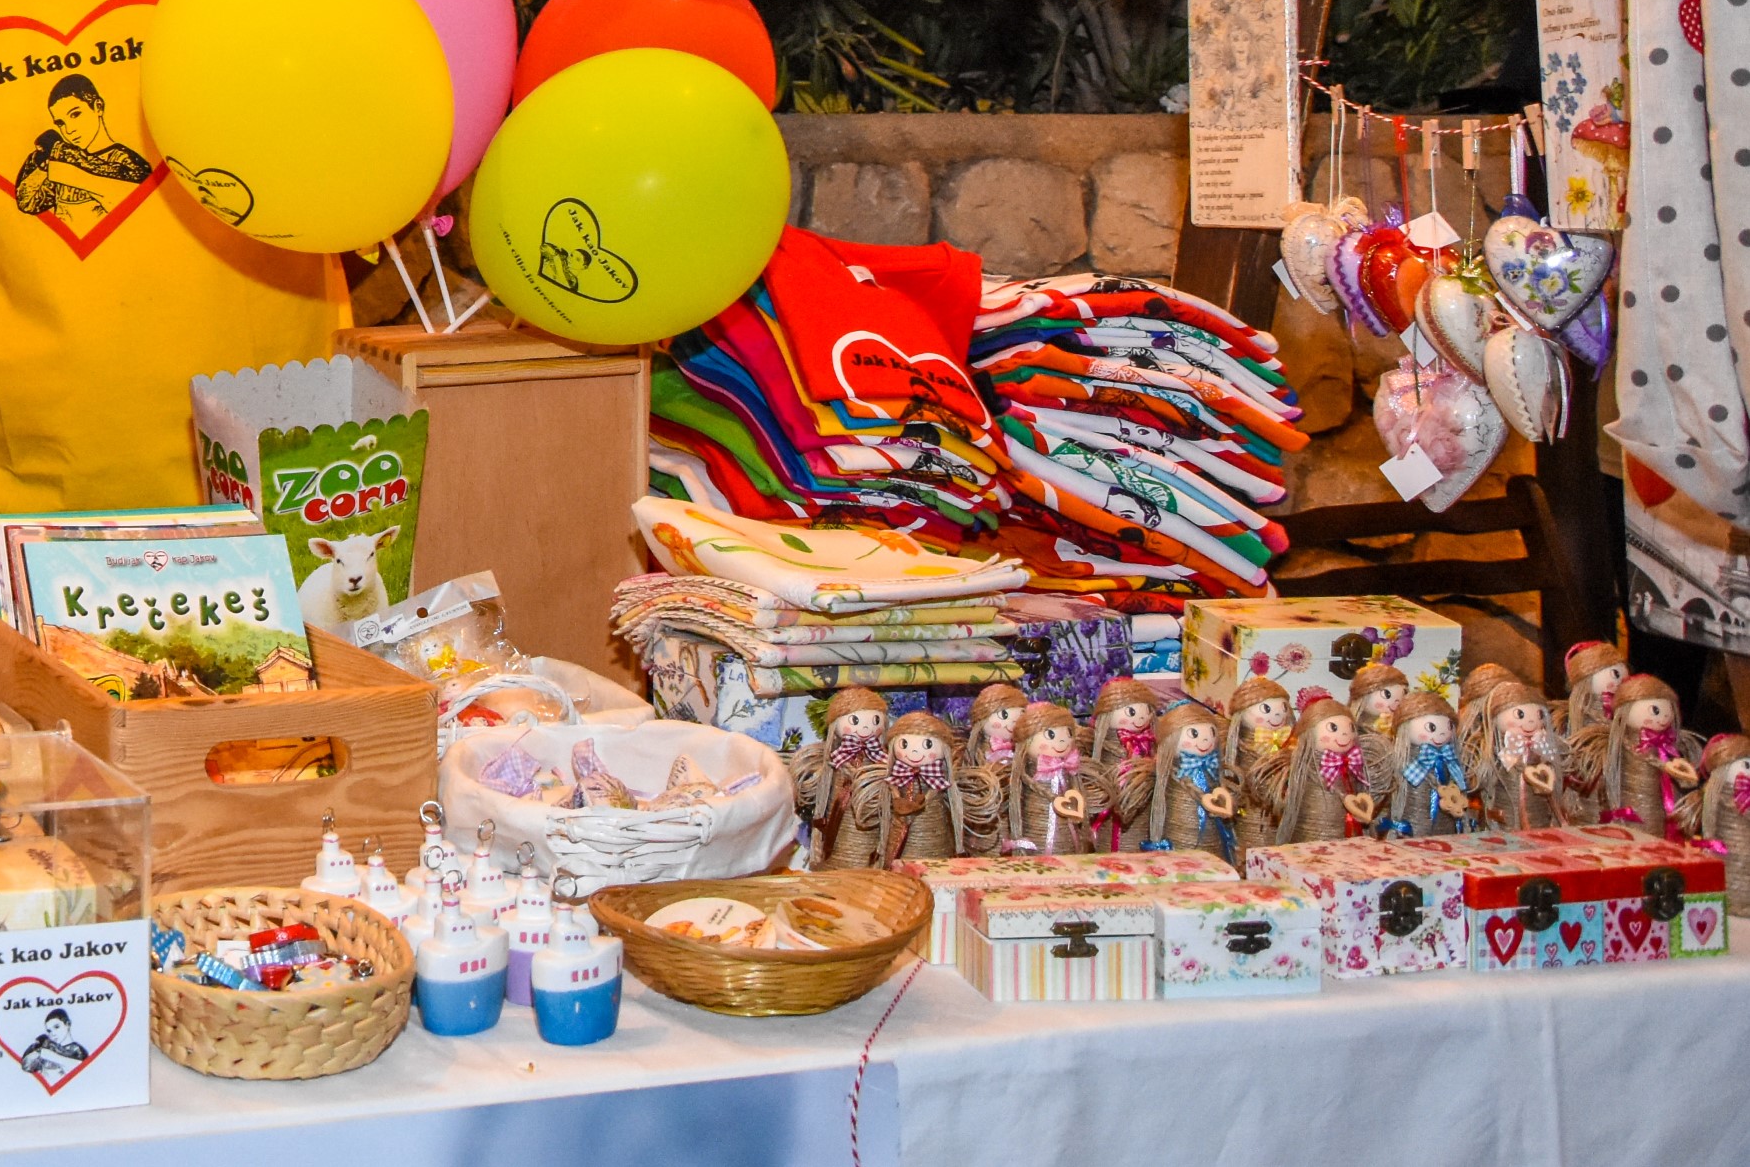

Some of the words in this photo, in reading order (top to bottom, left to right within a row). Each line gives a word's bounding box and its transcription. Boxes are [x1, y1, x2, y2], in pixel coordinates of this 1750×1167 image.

[23, 51, 82, 78] kao
[90, 37, 144, 65] Jak
[568, 208, 584, 233] Jak
[583, 233, 599, 256] kao
[598, 257, 629, 289] Jakov
[852, 353, 887, 368] Jak
[199, 429, 249, 484] ZOO
[210, 466, 254, 511] corn
[275, 452, 403, 513] ZOO
[303, 477, 409, 524] corn
[189, 553, 217, 564] Jakov
[62, 586, 270, 631] Krečekeš
[12, 945, 53, 964] kao
[60, 940, 128, 959] Jakov
[3, 998, 33, 1011] Jak
[36, 996, 63, 1008] kao
[67, 991, 114, 1005] Jakov
